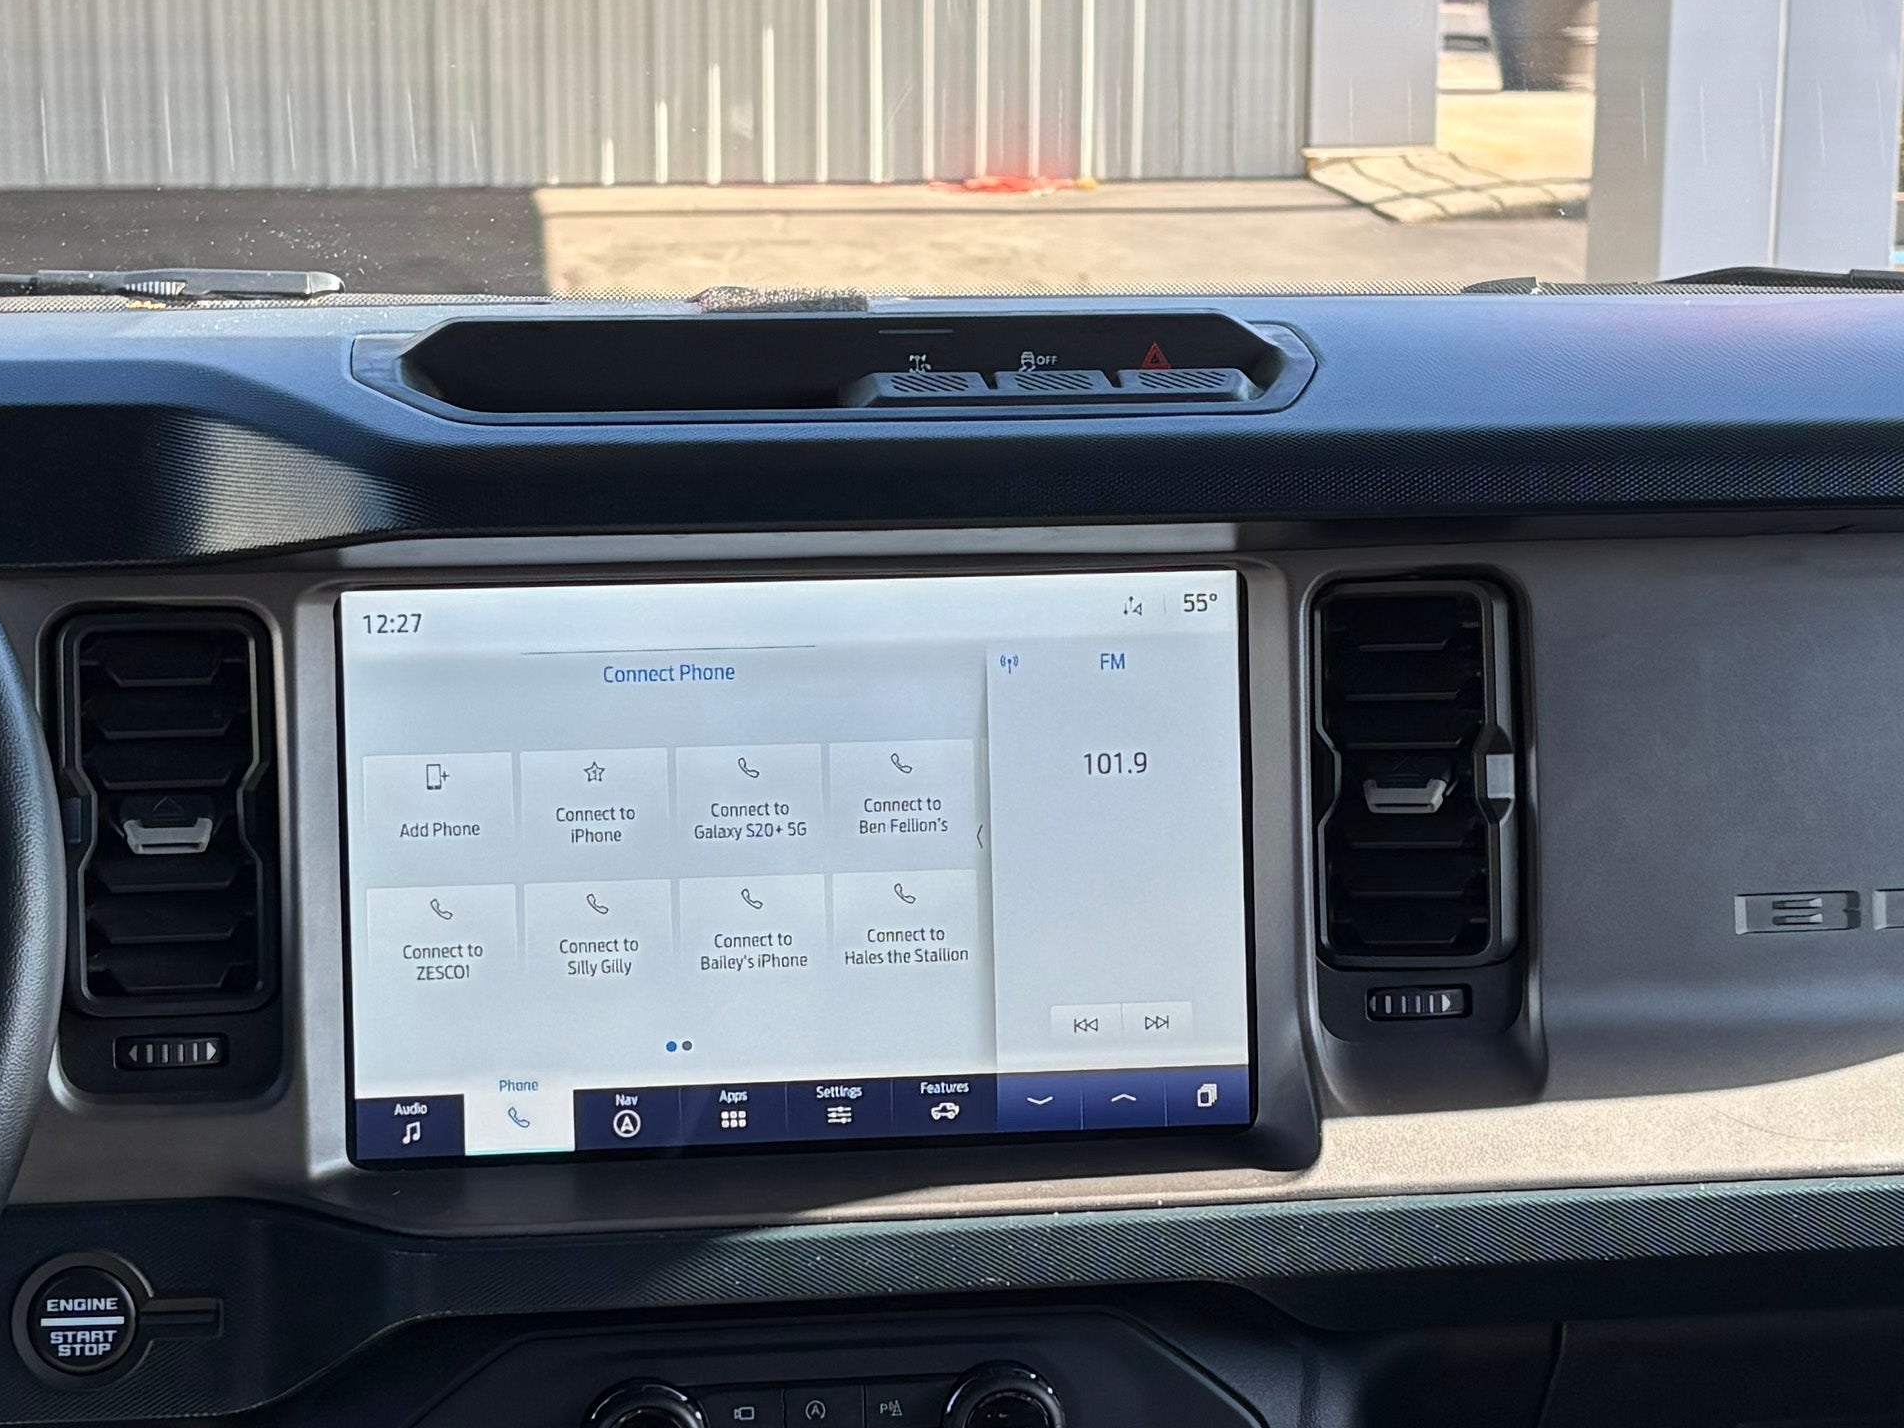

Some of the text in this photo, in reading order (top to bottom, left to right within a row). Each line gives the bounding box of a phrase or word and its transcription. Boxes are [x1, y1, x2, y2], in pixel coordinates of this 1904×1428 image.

[1036, 355, 1058, 366] OFF
[1182, 592, 1218, 613] 55°
[362, 613, 423, 634] 12:27
[1099, 652, 1126, 671] FM
[603, 662, 736, 684] Connect Phone
[1082, 750, 1149, 776] 101.9
[710, 801, 790, 818] Connect to
[863, 796, 942, 813] Connect to
[555, 805, 636, 822] Connect to
[399, 821, 481, 838] Add Phone
[570, 827, 622, 843] iPhone
[694, 821, 807, 841] Galaxy S20+ 5G
[859, 819, 886, 835] Ben
[713, 932, 793, 949] Connect to
[866, 927, 945, 944] Connect to
[402, 943, 484, 959] Connect to
[559, 938, 639, 955] Connect to
[700, 953, 808, 972] Bailey's iPhone
[844, 947, 969, 965] Hales the Stallion
[567, 958, 633, 976] Silly Gilly
[498, 1079, 539, 1093] Phone
[816, 1085, 863, 1101] Settings
[919, 1081, 969, 1095] Features
[615, 1094, 638, 1107] Nav
[719, 1090, 748, 1105] Apps
[394, 1103, 428, 1115] Audio
[46, 1297, 119, 1312] ENGINE
[50, 1330, 117, 1344] START
[57, 1343, 112, 1357] STOP
